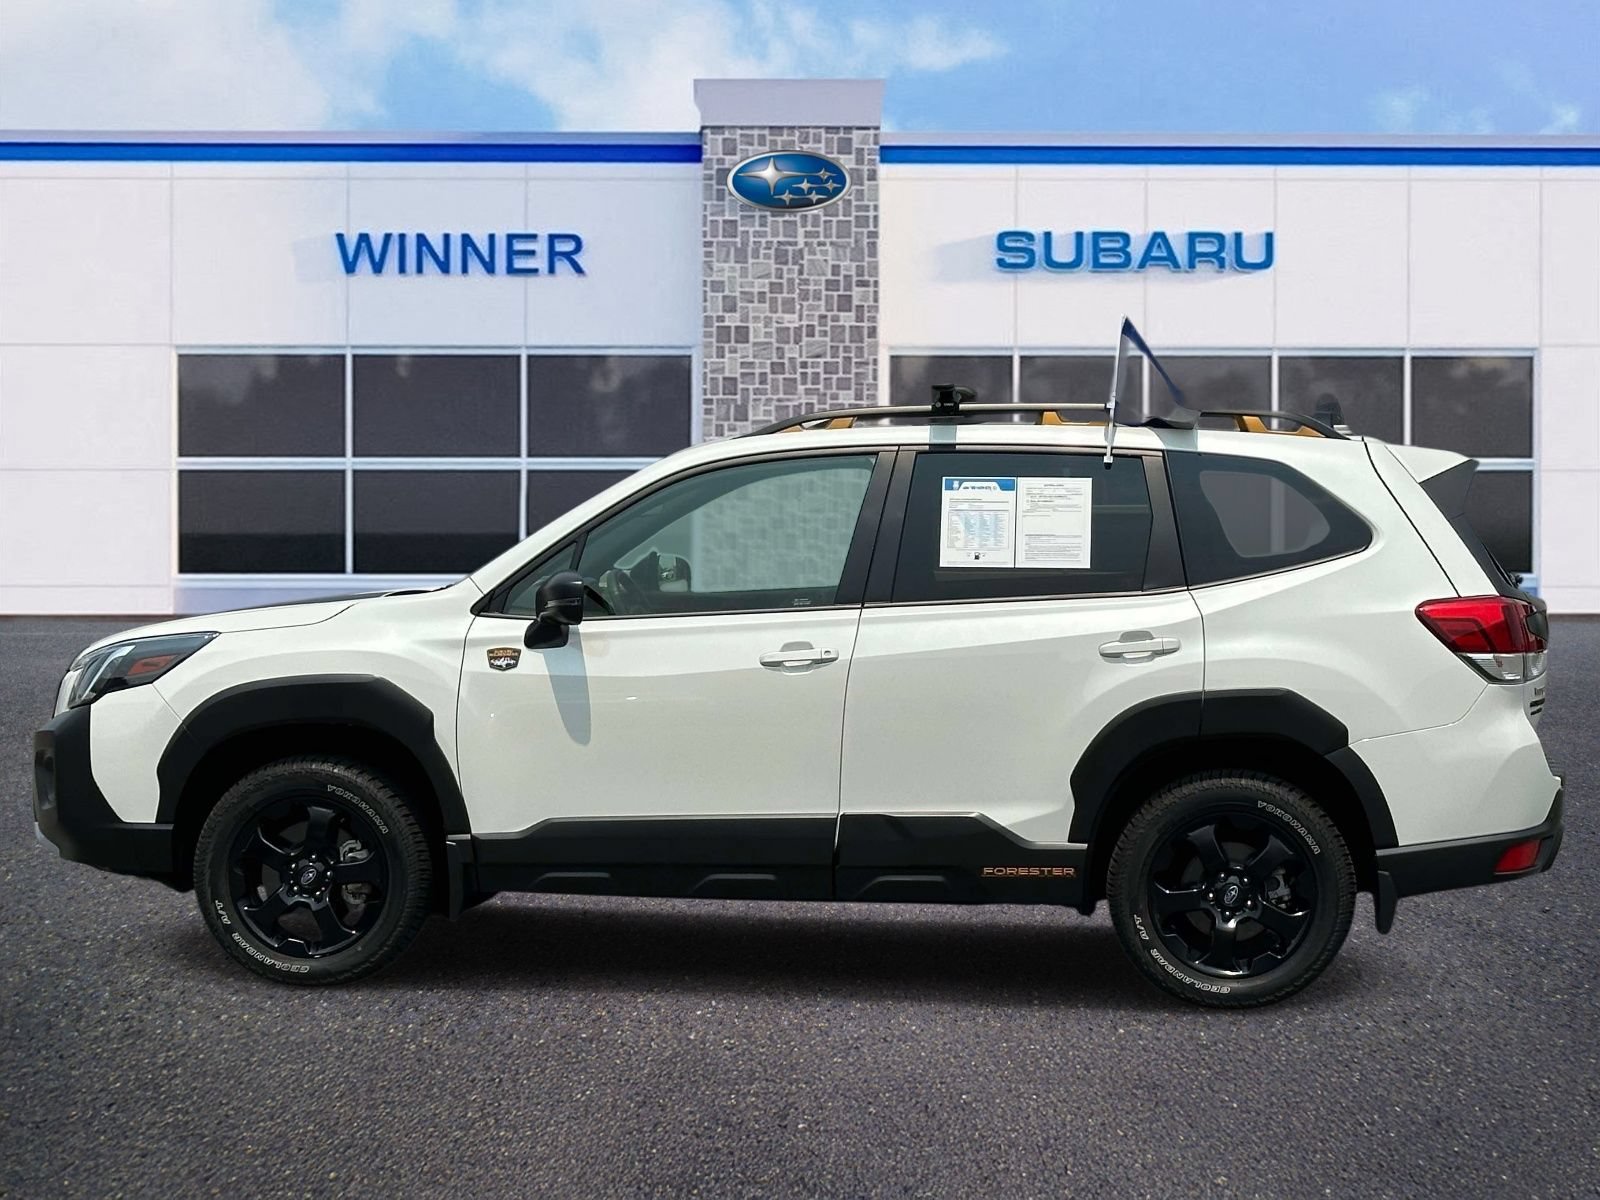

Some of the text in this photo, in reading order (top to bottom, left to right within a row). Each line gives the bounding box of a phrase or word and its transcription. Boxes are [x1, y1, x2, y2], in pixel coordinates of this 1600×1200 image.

[335, 232, 588, 275] WINNER
[995, 230, 1275, 271] SUBARU
[327, 784, 390, 835] YOKOHAMA
[1257, 799, 1321, 855] YOKOHAMA
[982, 866, 1076, 877] FORESTER
[231, 931, 311, 974] GEOLANDAR
[1150, 948, 1231, 994] GEOLANDAR
